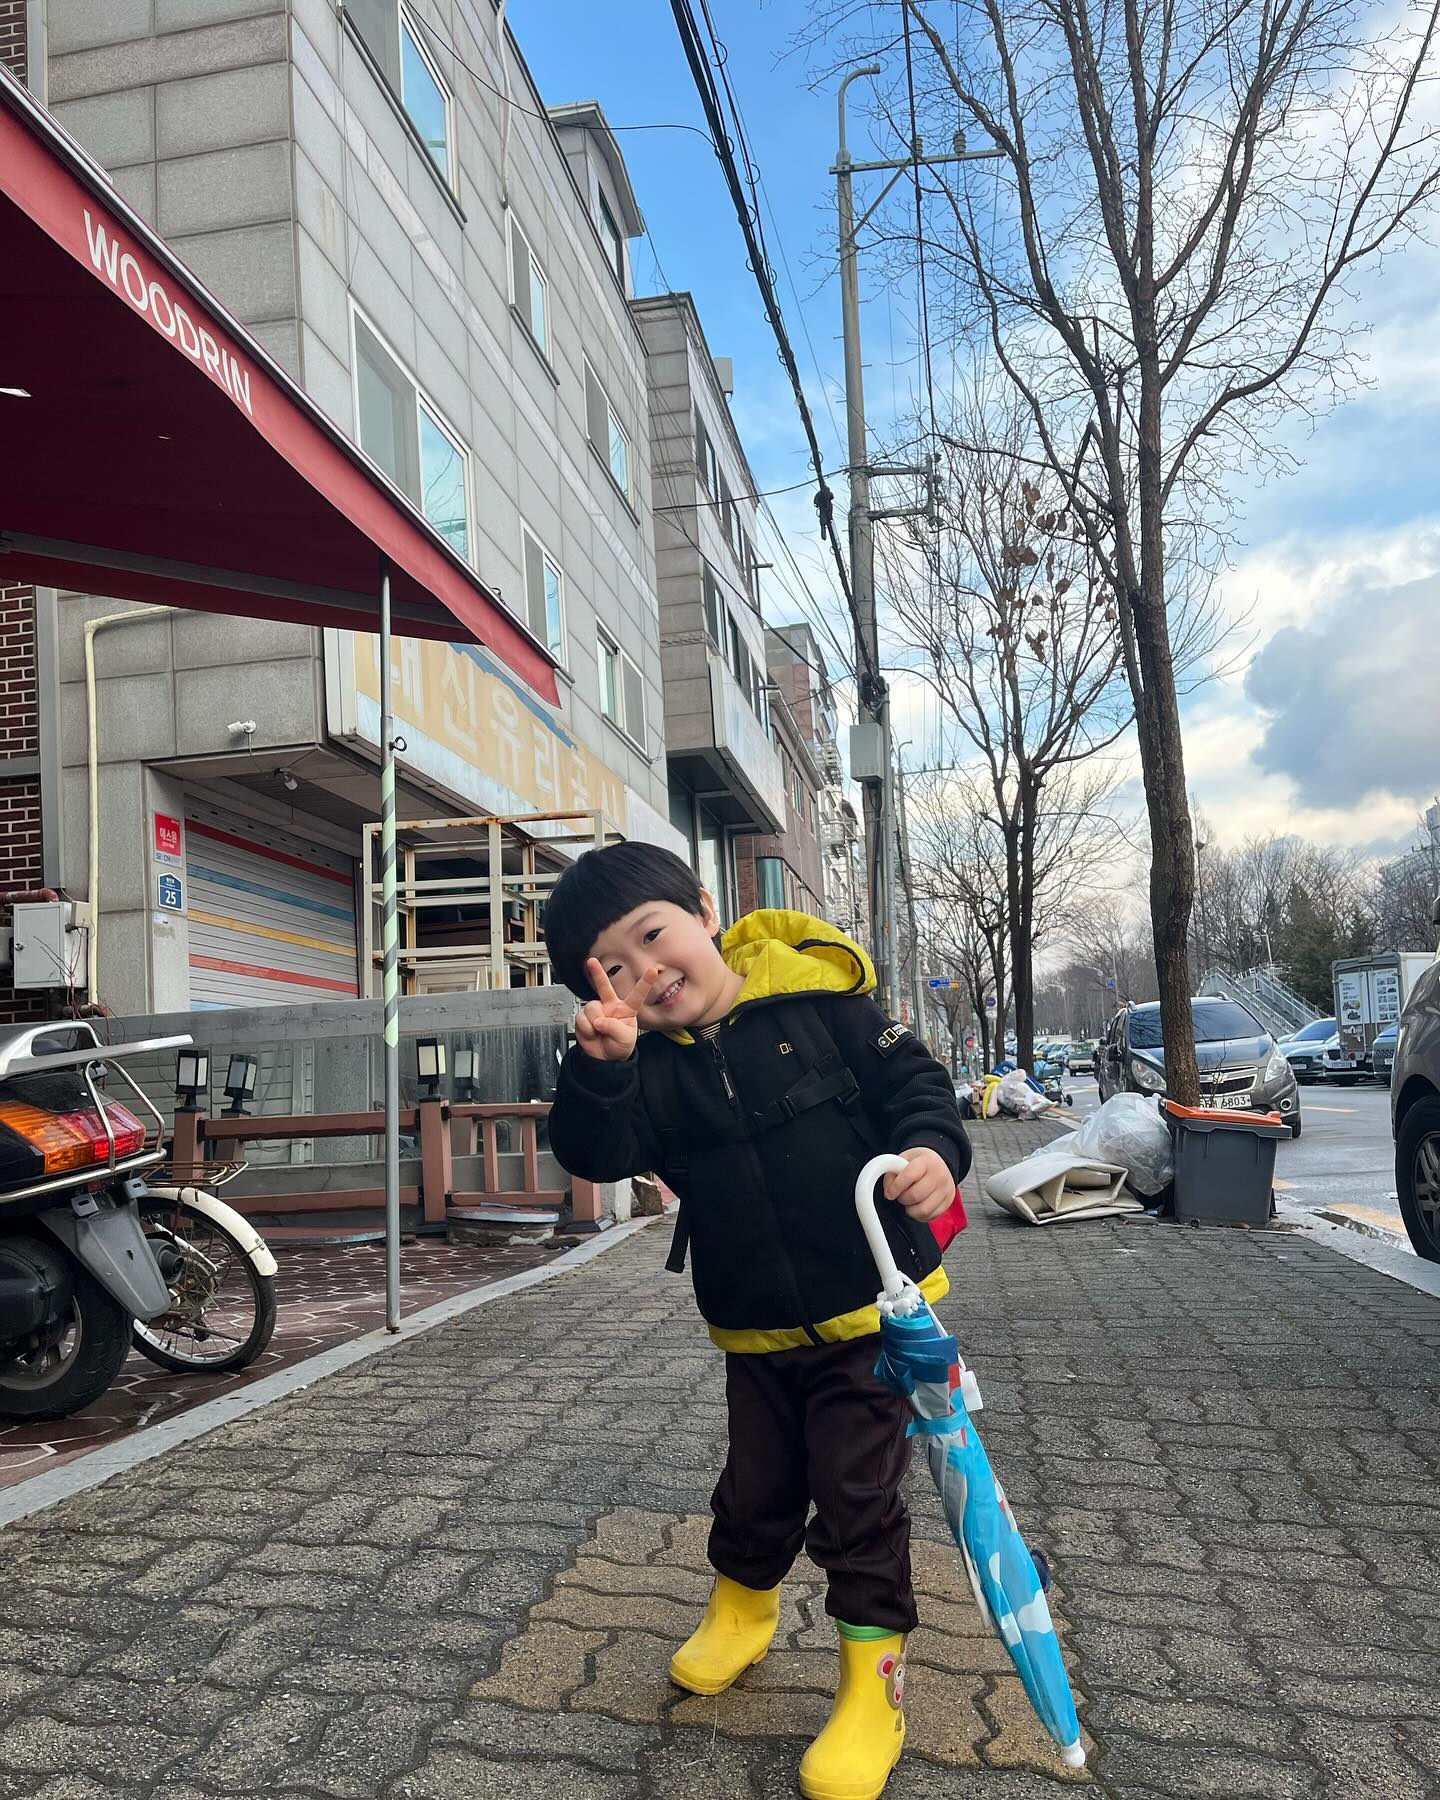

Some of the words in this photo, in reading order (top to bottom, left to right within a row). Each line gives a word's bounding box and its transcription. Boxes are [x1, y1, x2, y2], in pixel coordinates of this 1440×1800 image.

[83, 208, 253, 417] WOODRIN
[165, 890, 176, 905] 25
[1221, 1096, 1246, 1108] 6803
